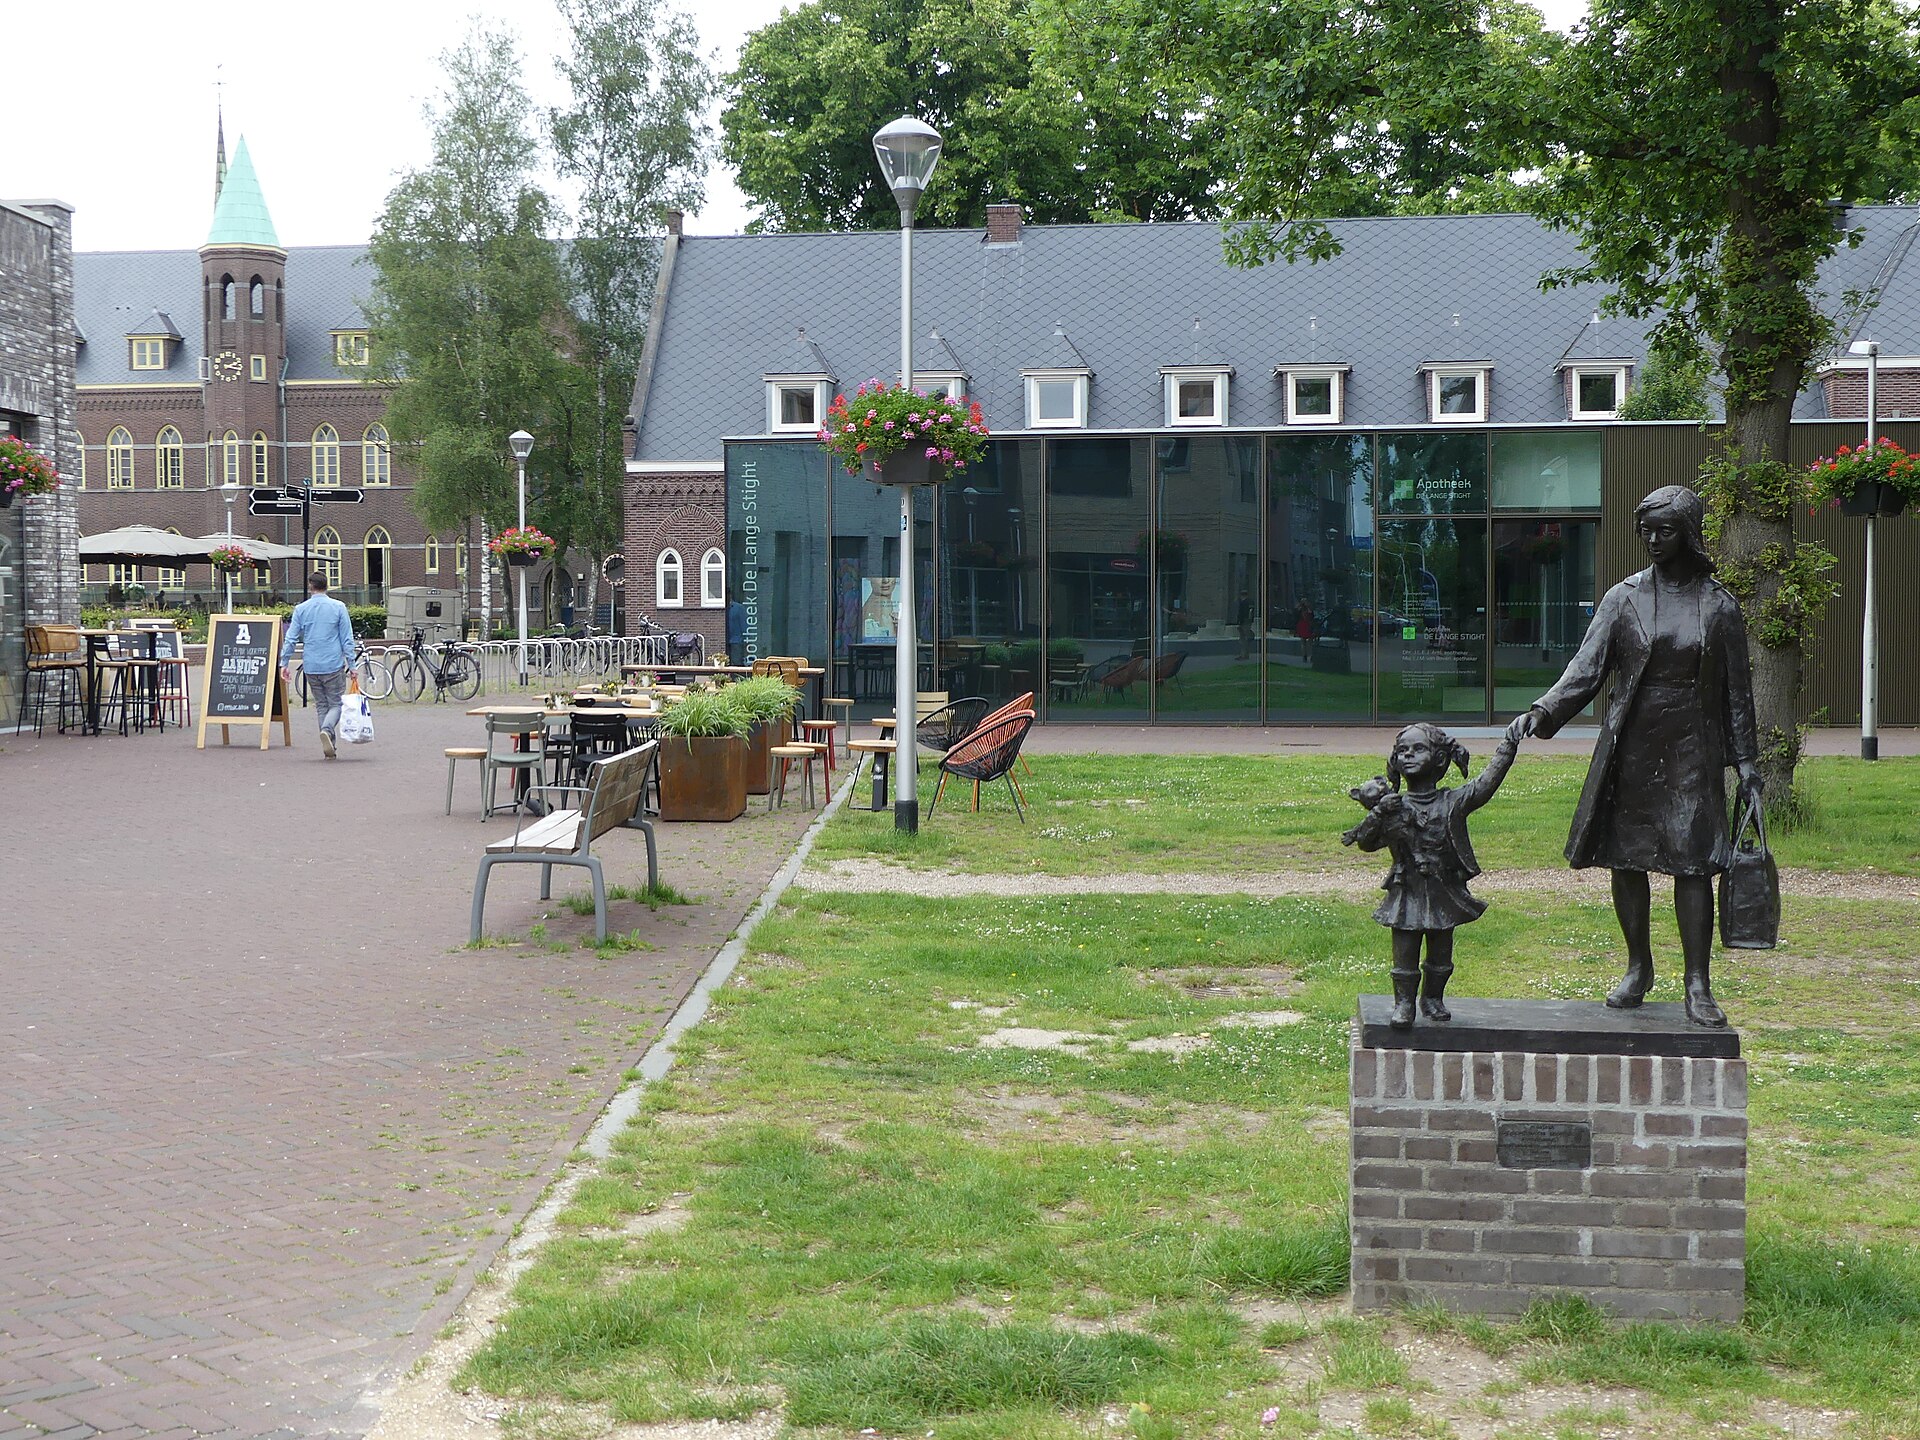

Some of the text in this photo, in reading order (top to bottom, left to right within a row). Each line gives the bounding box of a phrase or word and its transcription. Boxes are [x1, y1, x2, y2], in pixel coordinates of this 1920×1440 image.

[1416, 478, 1472, 492] Apotheek
[741, 461, 760, 666] potheek De Lange Stight
[236, 623, 251, 645] A
